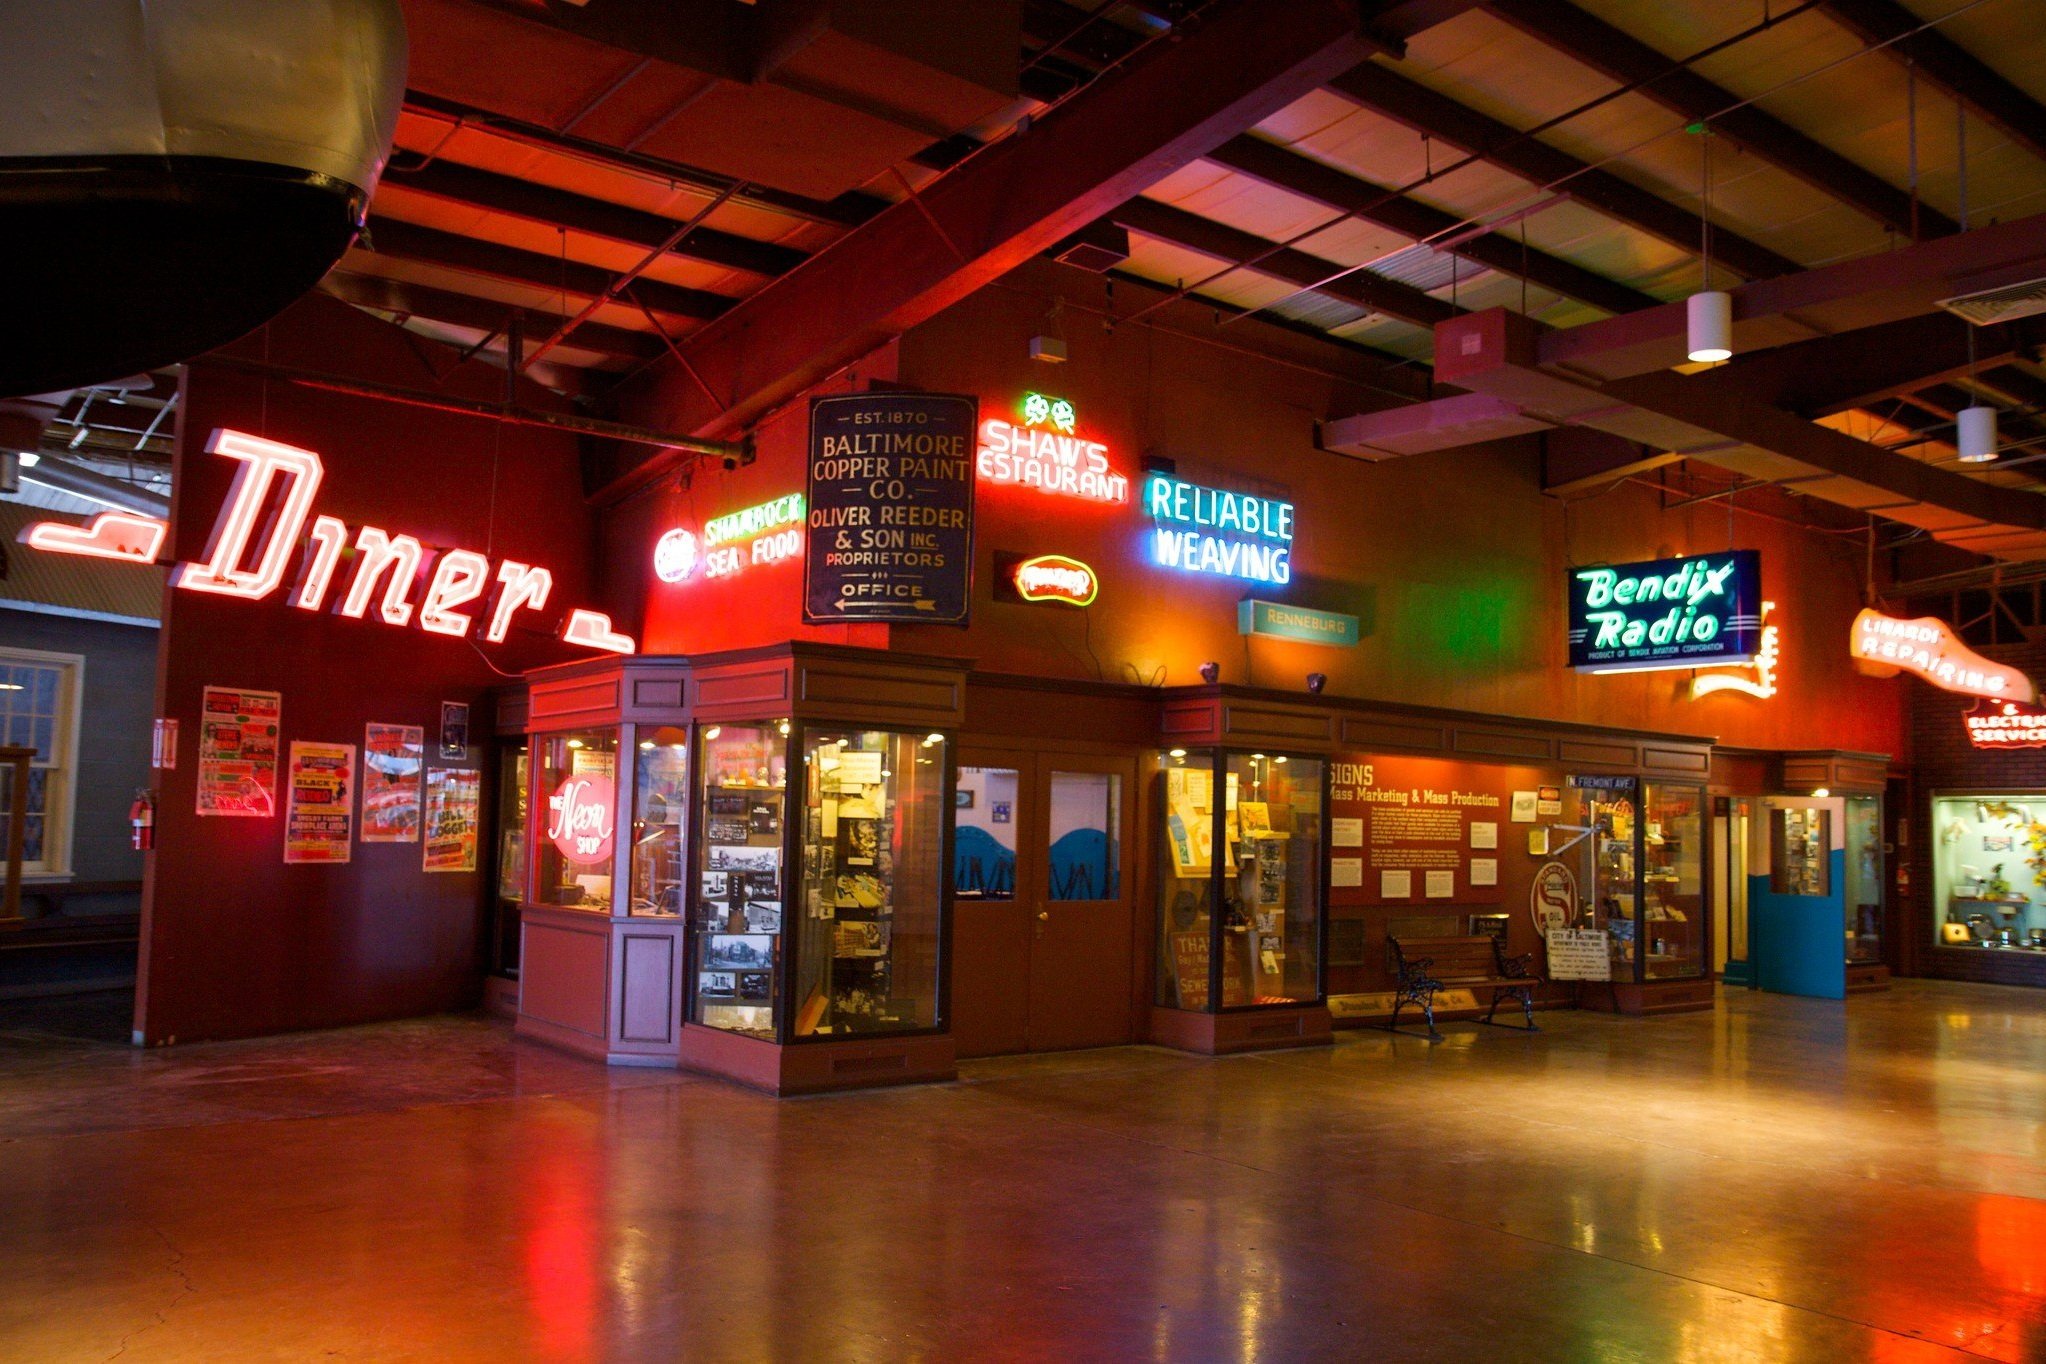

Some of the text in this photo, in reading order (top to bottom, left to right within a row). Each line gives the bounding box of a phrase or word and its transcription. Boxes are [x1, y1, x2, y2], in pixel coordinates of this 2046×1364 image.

[823, 434, 965, 457] BALTIMORE
[987, 421, 1108, 473] SHAW'S
[814, 457, 969, 481] COPPER PAINT
[977, 450, 1127, 500] ESTAURANT
[869, 480, 913, 500] CO.
[704, 493, 802, 546] SHAMROCK
[811, 506, 964, 529] OLIVER REEDER
[1152, 477, 1294, 540] RELIABLE
[168, 428, 553, 643] Diner
[835, 529, 940, 549] & SON INC.
[706, 547, 739, 578] SEA
[752, 530, 800, 565] FOOD
[826, 552, 945, 567] PROPRIETORS
[1157, 528, 1290, 584] WEAVING
[841, 584, 923, 597] OFFICE
[1576, 559, 1735, 609] Bendix
[1267, 608, 1345, 634] RENNEBURG
[1585, 605, 1719, 648] Radio
[1588, 650, 1615, 660] PRODUCT
[1617, 650, 1625, 659] OF
[1628, 647, 1650, 657] BENDIX
[1682, 643, 1724, 654] CORPORATION
[1862, 637, 2005, 691] REPAIRING
[1578, 776, 1613, 788] FREMONT
[1356, 787, 1408, 806] Marketing
[1412, 789, 1420, 804] &
[1423, 789, 1449, 805] Mass
[1451, 791, 1499, 807] Production
[577, 836, 600, 855] SHOP
